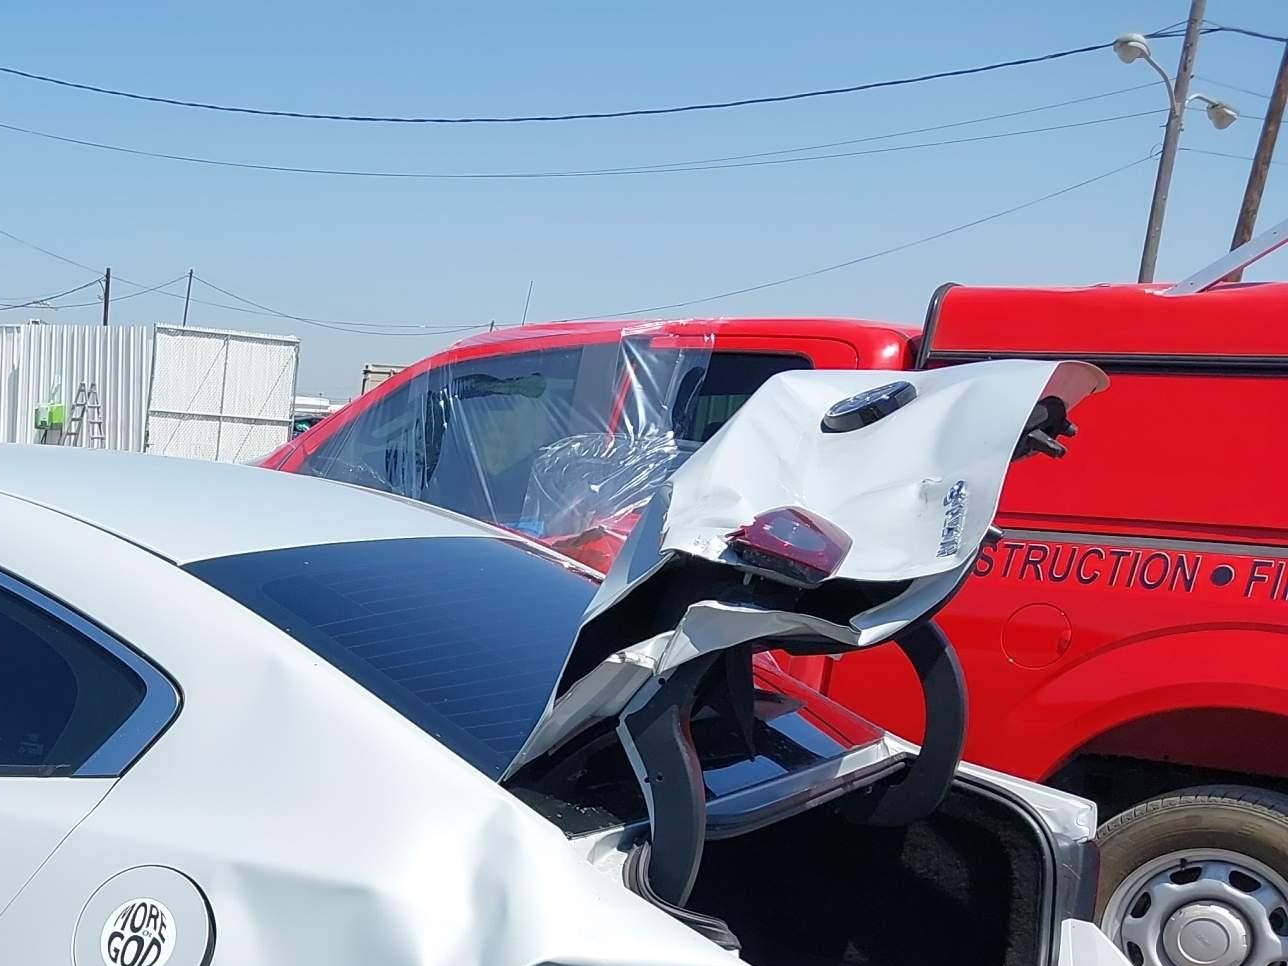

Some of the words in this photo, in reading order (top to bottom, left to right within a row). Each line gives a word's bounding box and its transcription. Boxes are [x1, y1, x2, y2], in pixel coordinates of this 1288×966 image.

[973, 541, 1202, 593] STRUCTION
[1243, 559, 1288, 601] FI
[113, 902, 167, 944] MORE
